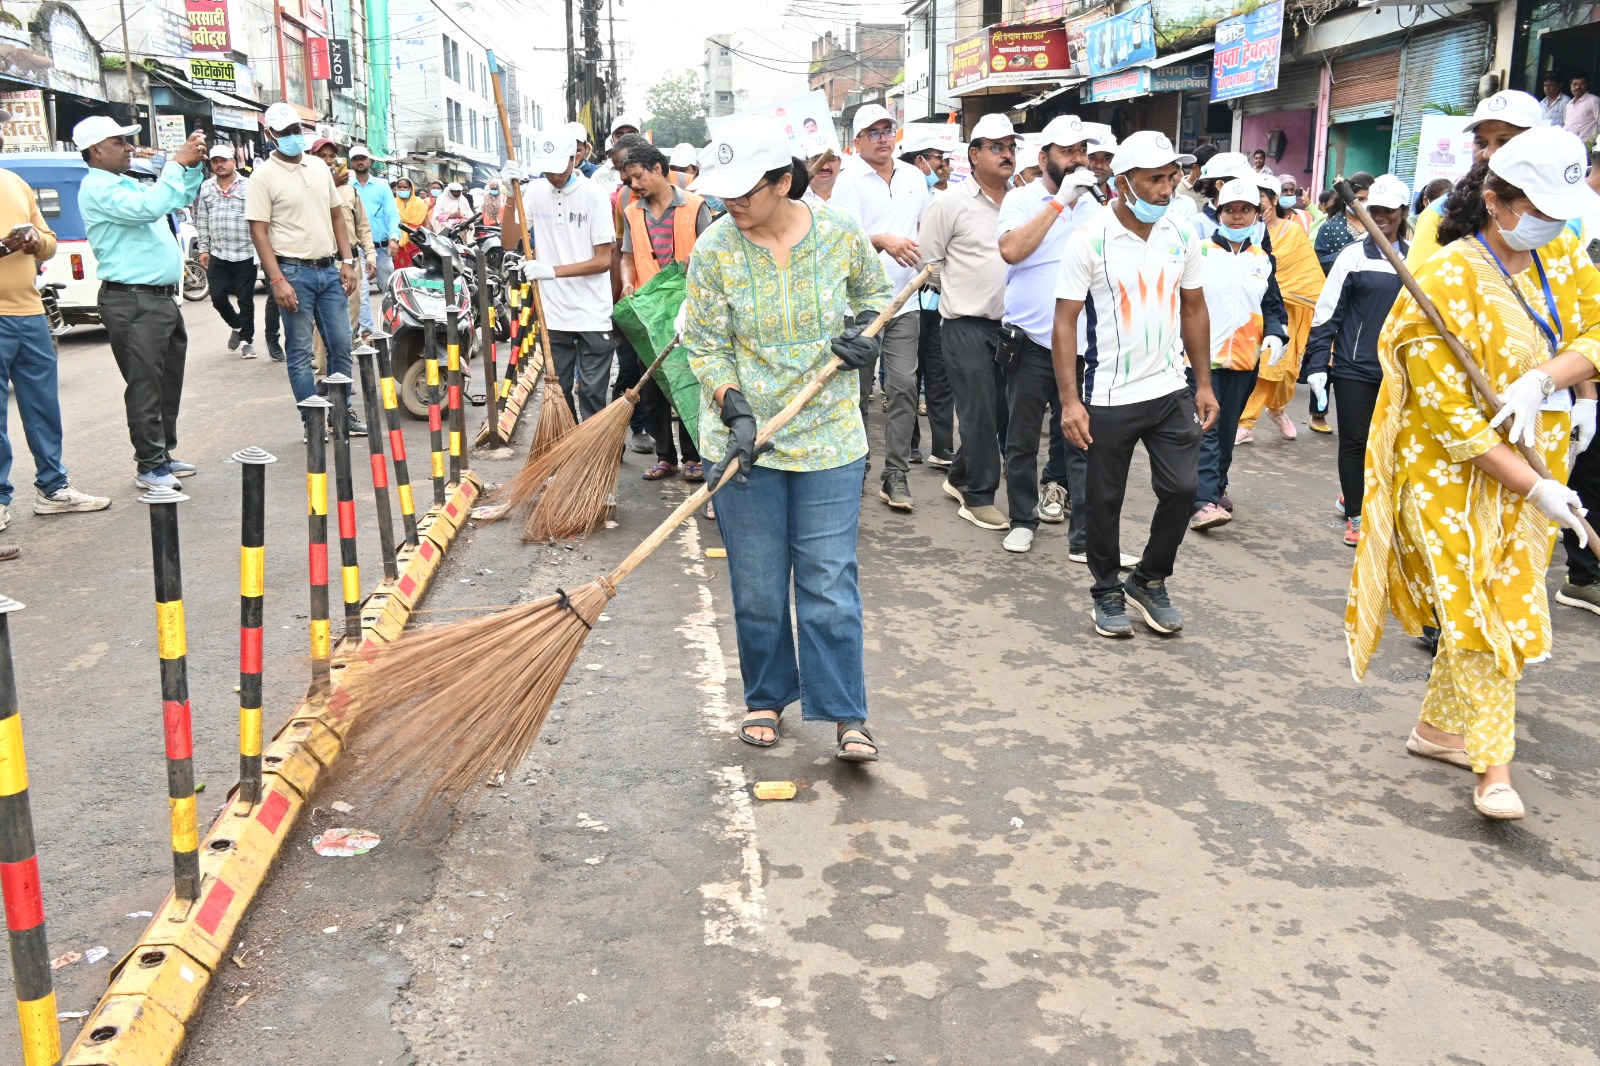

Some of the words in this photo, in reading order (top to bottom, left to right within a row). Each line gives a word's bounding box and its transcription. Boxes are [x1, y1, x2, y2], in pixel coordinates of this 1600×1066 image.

[187, 7, 225, 26] परसादी
[191, 60, 234, 79] फोटोकॉपी
[332, 41, 343, 85] SONY
[1156, 66, 1189, 76] सपना
[1214, 46, 1241, 78] गुप्ता
[1217, 74, 1233, 91] GUPTA
[1232, 69, 1255, 86] TRAVELS
